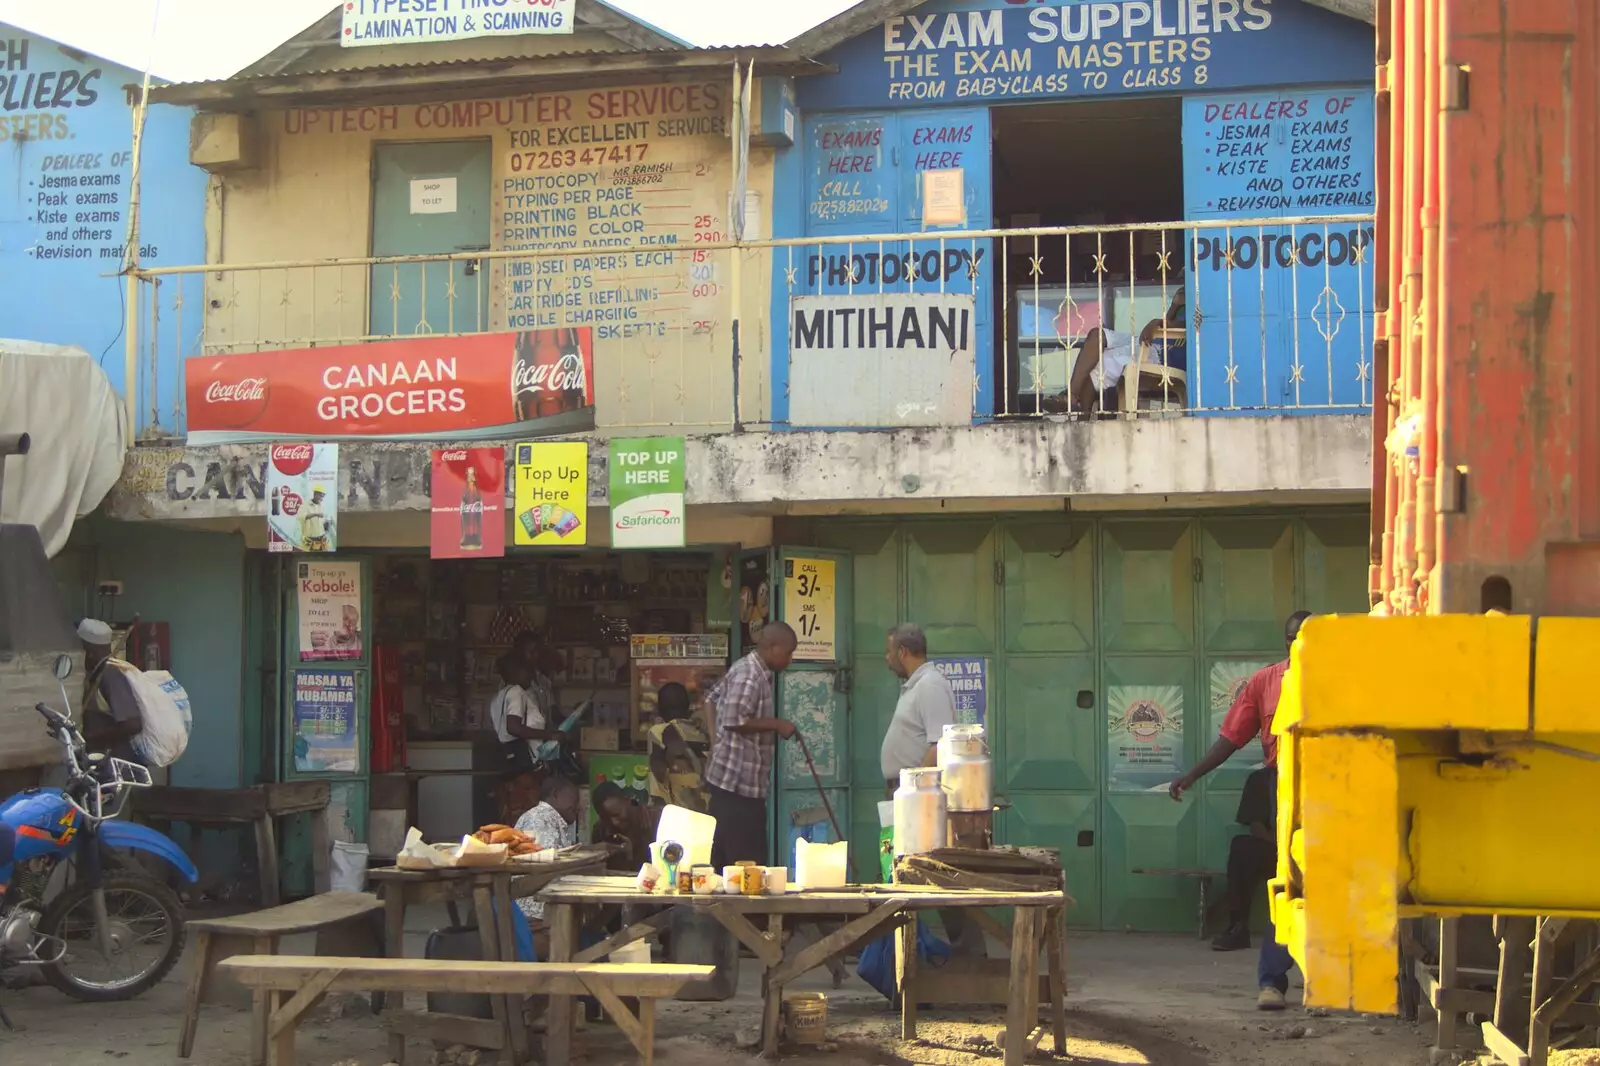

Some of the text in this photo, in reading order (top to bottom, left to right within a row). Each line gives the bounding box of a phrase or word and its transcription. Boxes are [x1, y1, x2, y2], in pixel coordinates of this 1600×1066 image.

[354, 11, 563, 40] LAMINATION & SCANNING
[883, 0, 1272, 52] EXAM SUPPLIERS
[883, 37, 1212, 79] THE EXAM MASTERS
[888, 65, 1209, 100] FROM BABYCLASS TO CLASS 8
[284, 83, 720, 134] UPTECH COMPUTER SERVICES
[1204, 97, 1356, 123] DEALERS OF
[510, 116, 727, 148] FOR EXCELLENT SERVICES
[821, 129, 882, 150] EXAMS
[912, 124, 974, 146] EXAMS
[1216, 119, 1350, 140] JESMA EXAMS
[1216, 137, 1353, 158] PEAK EXAMS
[41, 151, 132, 172] DEALERS OF
[613, 162, 673, 177] MR RAMISH
[827, 155, 875, 174] HERE
[914, 151, 963, 170] HERE
[1217, 155, 1351, 176] KISTE EXAMS
[38, 173, 121, 189] Jesma exams
[503, 172, 599, 192] PHOTOCOPY
[823, 181, 862, 197] CALL
[1246, 172, 1361, 192] AND OTHERS
[37, 191, 118, 206] Peak exams
[504, 187, 633, 208] TYPING PER PAGE
[1217, 190, 1373, 212] REVISION MATERIALS
[37, 209, 120, 224] Kiste exams
[504, 203, 642, 226] PRINTING BLACK
[46, 226, 112, 241] and others
[504, 224, 577, 241] PRINTING
[589, 220, 645, 236] COLOR
[35, 245, 92, 259] Revision
[1189, 226, 1374, 272] PHOTOCOP
[573, 256, 628, 272] PAPERS
[635, 251, 673, 267] EACH
[808, 247, 985, 287] PHOTOCOPY
[508, 306, 637, 328] MOBILE CHARGING
[795, 306, 969, 350] MITIHANI
[322, 357, 457, 390] CANAAN
[317, 388, 466, 420] GROCERS
[617, 451, 678, 466] TOP UP
[523, 467, 580, 484] Top Up
[625, 470, 670, 484] HERE
[532, 487, 569, 500] Here
[621, 515, 681, 526] Safaricom
[802, 564, 818, 572] CALL
[302, 579, 355, 592] Kobole!
[797, 574, 820, 597] 3/-
[802, 604, 816, 612] SMS
[799, 613, 820, 637] 1/-
[965, 662, 982, 674] YA
[297, 674, 354, 686] MASAA YA
[296, 690, 354, 702] KUBAMBA
